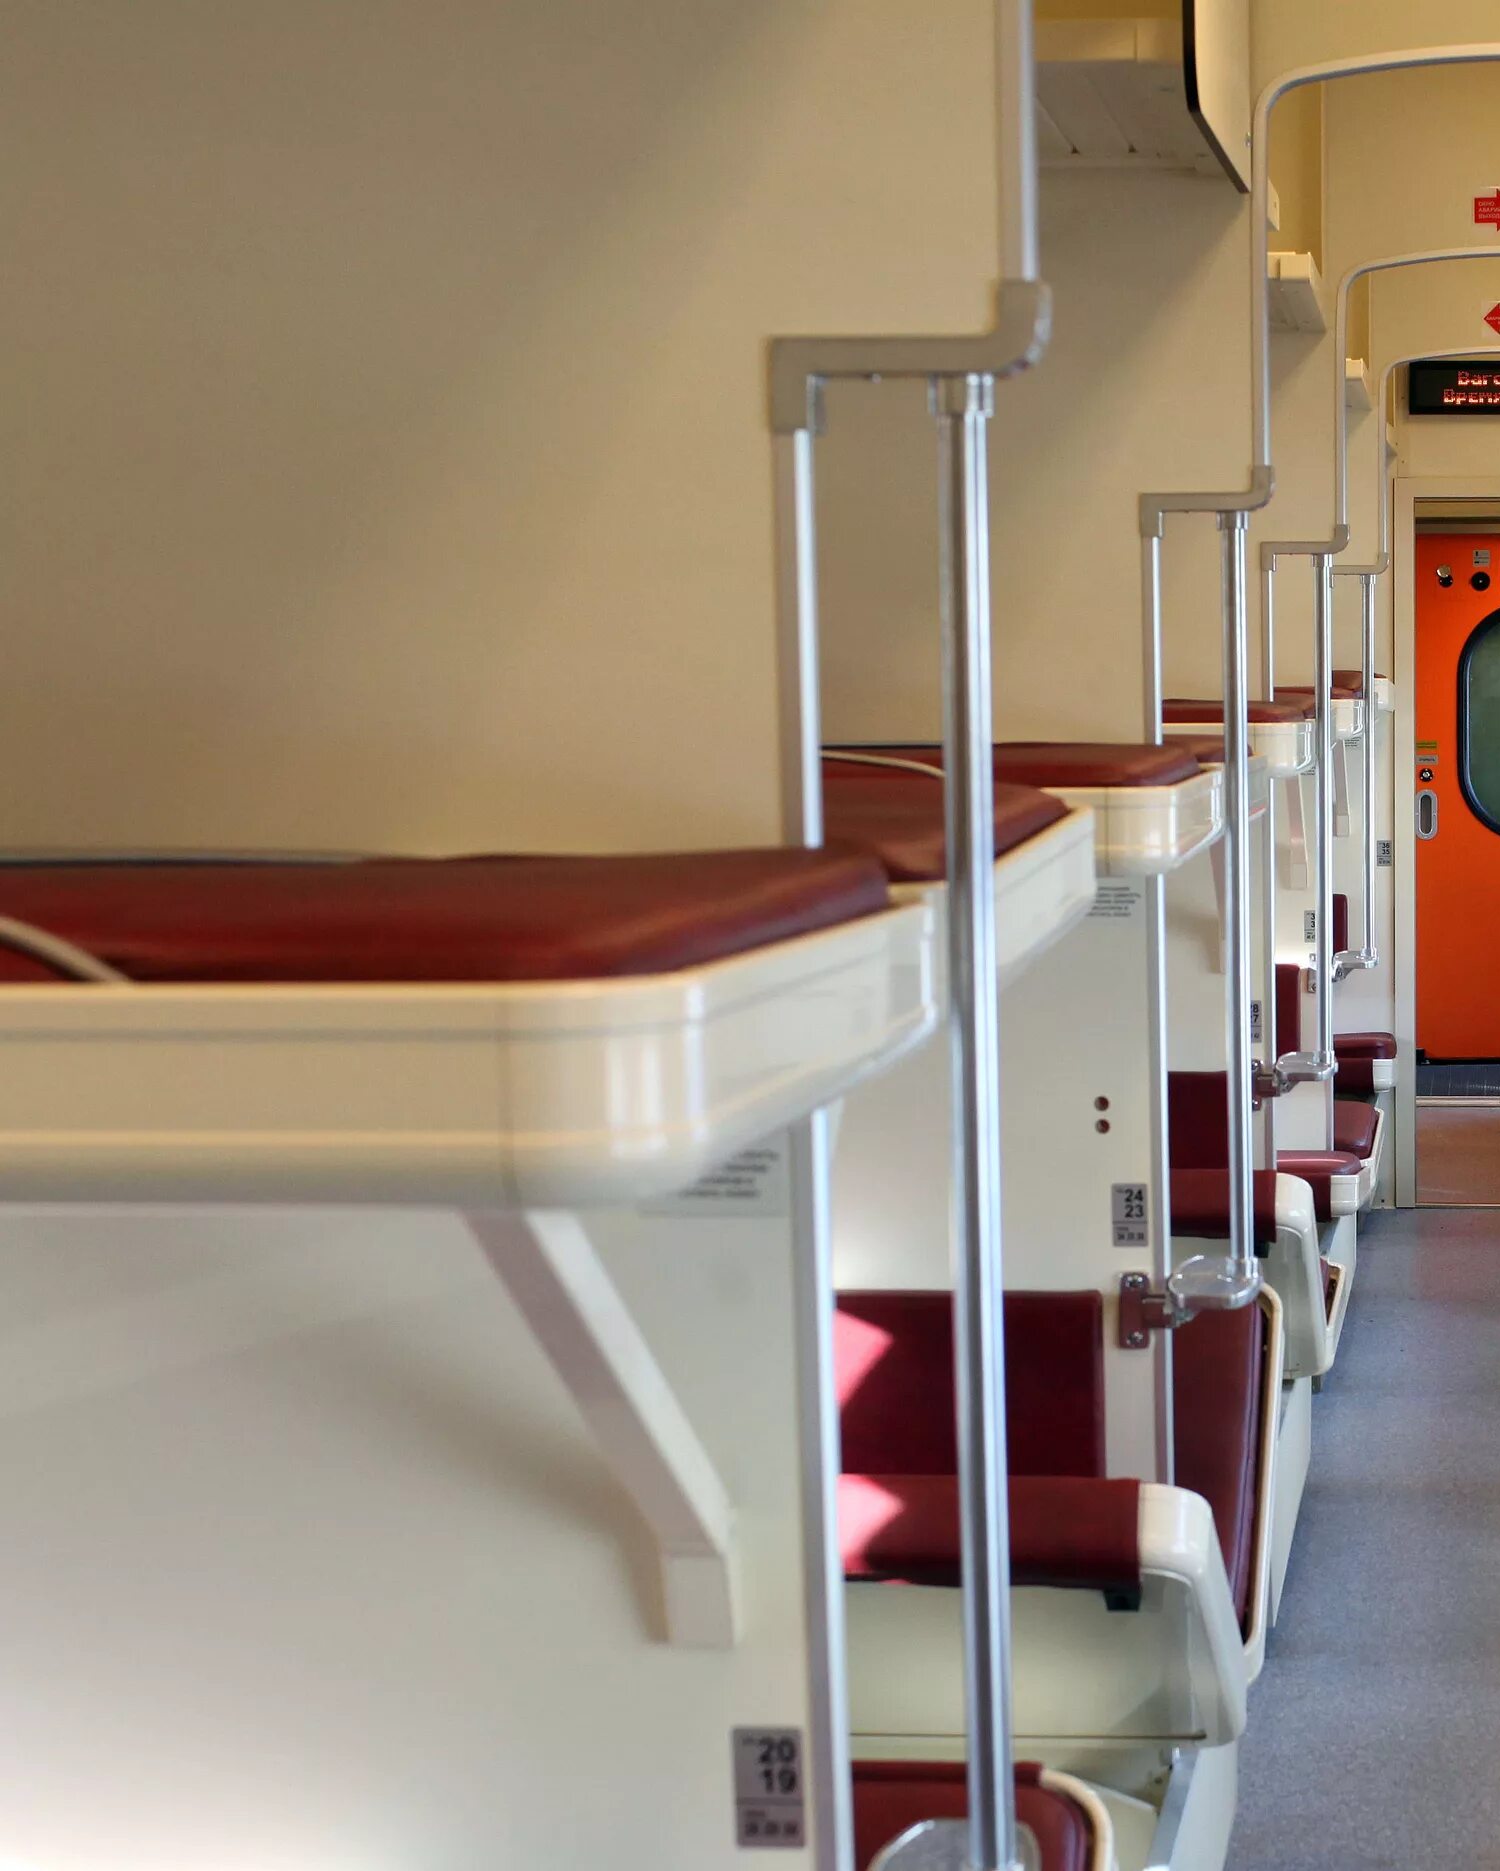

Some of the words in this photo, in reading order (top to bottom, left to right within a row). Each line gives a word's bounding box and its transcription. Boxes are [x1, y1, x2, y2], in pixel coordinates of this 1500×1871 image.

[1310, 912, 1316, 920] 3
[1310, 920, 1316, 928] 3
[1250, 1003, 1259, 1013] 8
[1250, 1014, 1259, 1023] 7
[1124, 1188, 1143, 1202] 24
[1124, 1204, 1144, 1218] 23
[758, 1736, 796, 1763] 20
[761, 1768, 797, 1795] 19
